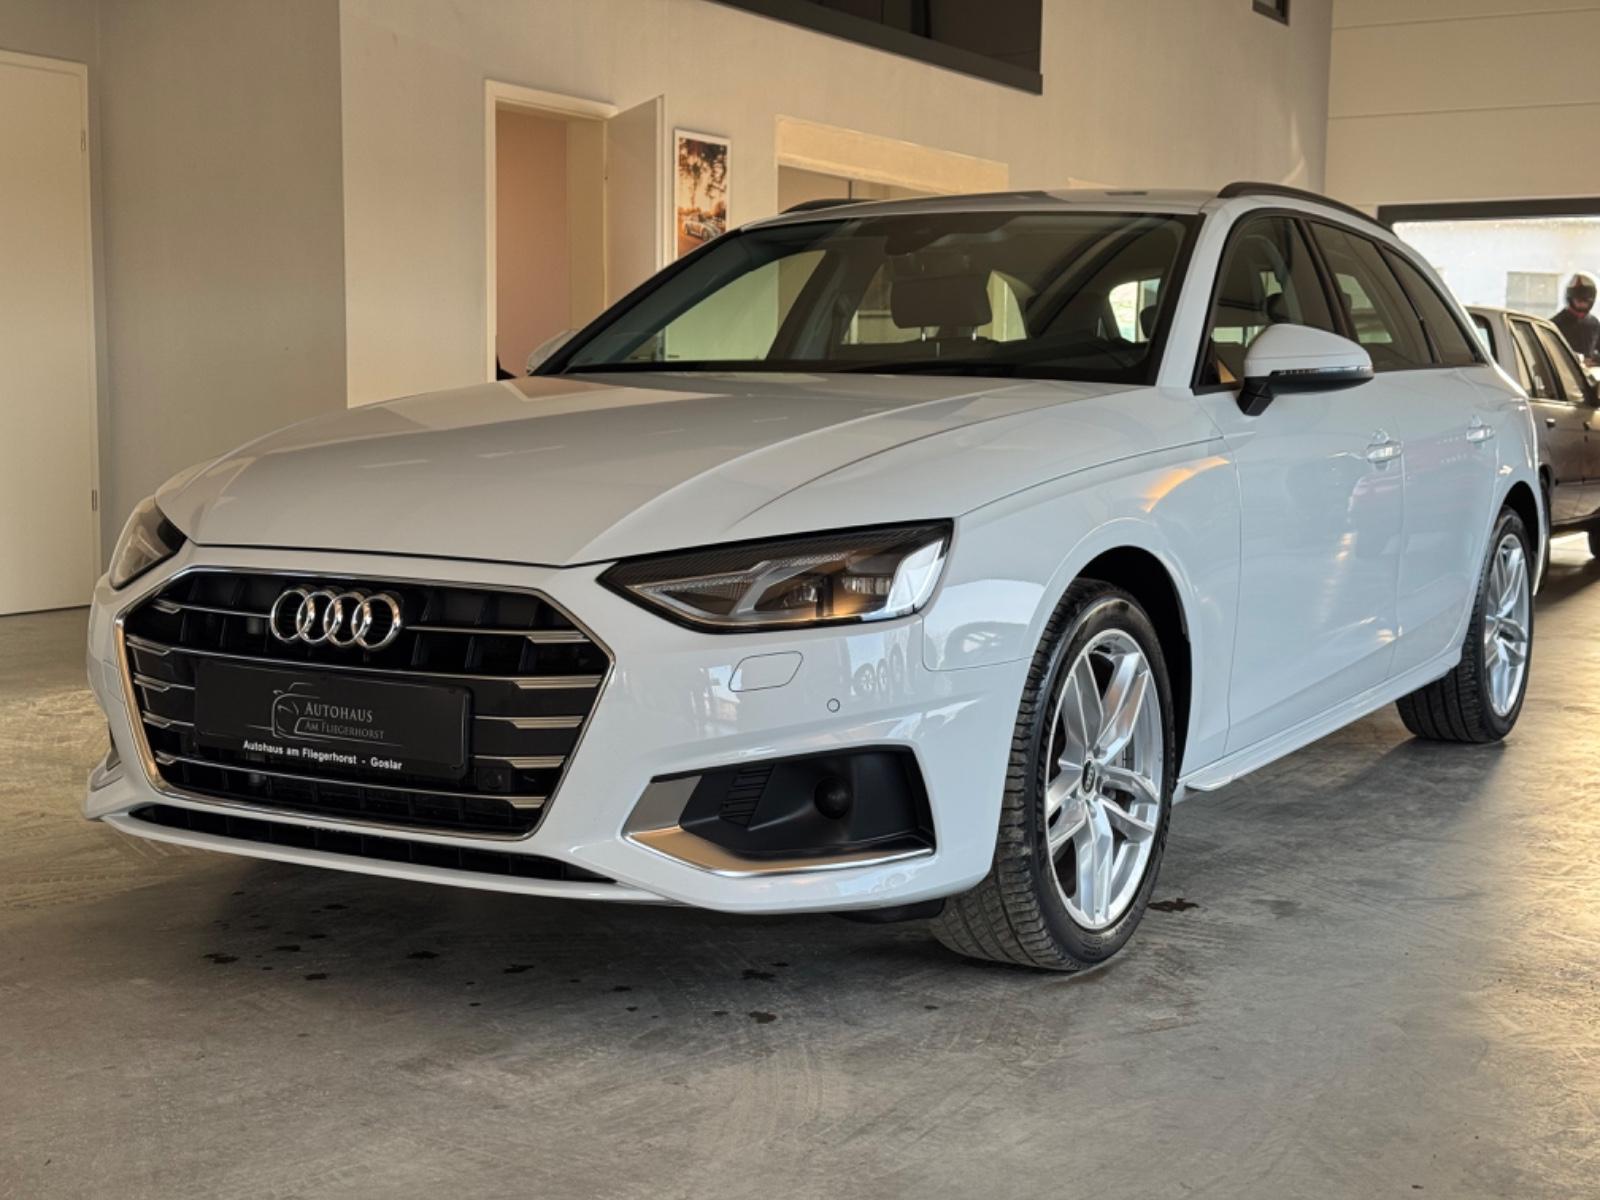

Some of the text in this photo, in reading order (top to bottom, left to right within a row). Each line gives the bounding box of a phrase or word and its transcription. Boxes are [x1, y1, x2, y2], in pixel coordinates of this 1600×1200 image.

[304, 702, 373, 723] AUTOHAUS
[322, 721, 384, 739] FLIEGERHORST
[243, 740, 283, 755] Autohaus
[286, 747, 299, 756] am
[302, 747, 357, 764] Fliegerhorst
[370, 757, 402, 770] Goslar
